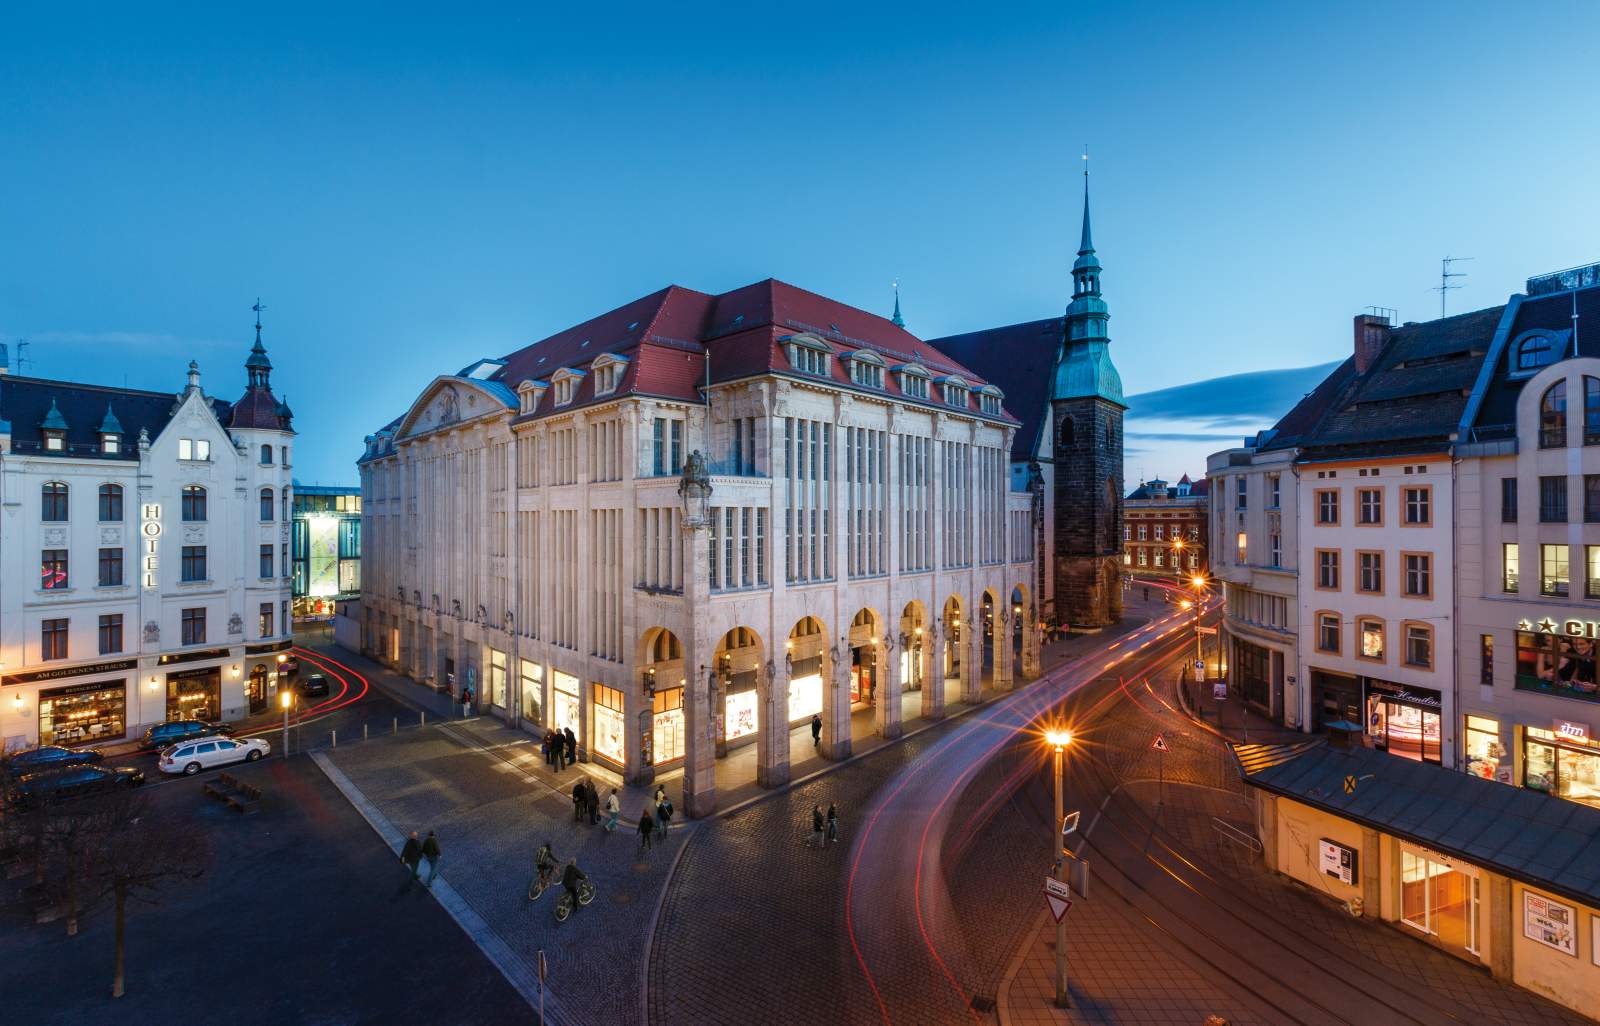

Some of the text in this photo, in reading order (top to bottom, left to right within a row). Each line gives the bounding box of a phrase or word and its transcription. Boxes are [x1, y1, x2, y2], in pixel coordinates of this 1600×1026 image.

[143, 504, 161, 588] HOTEL
[1565, 621, 1600, 638] CI
[36, 672, 50, 680] AM
[96, 663, 128, 672] STRAUSS
[1560, 722, 1584, 737] dm
